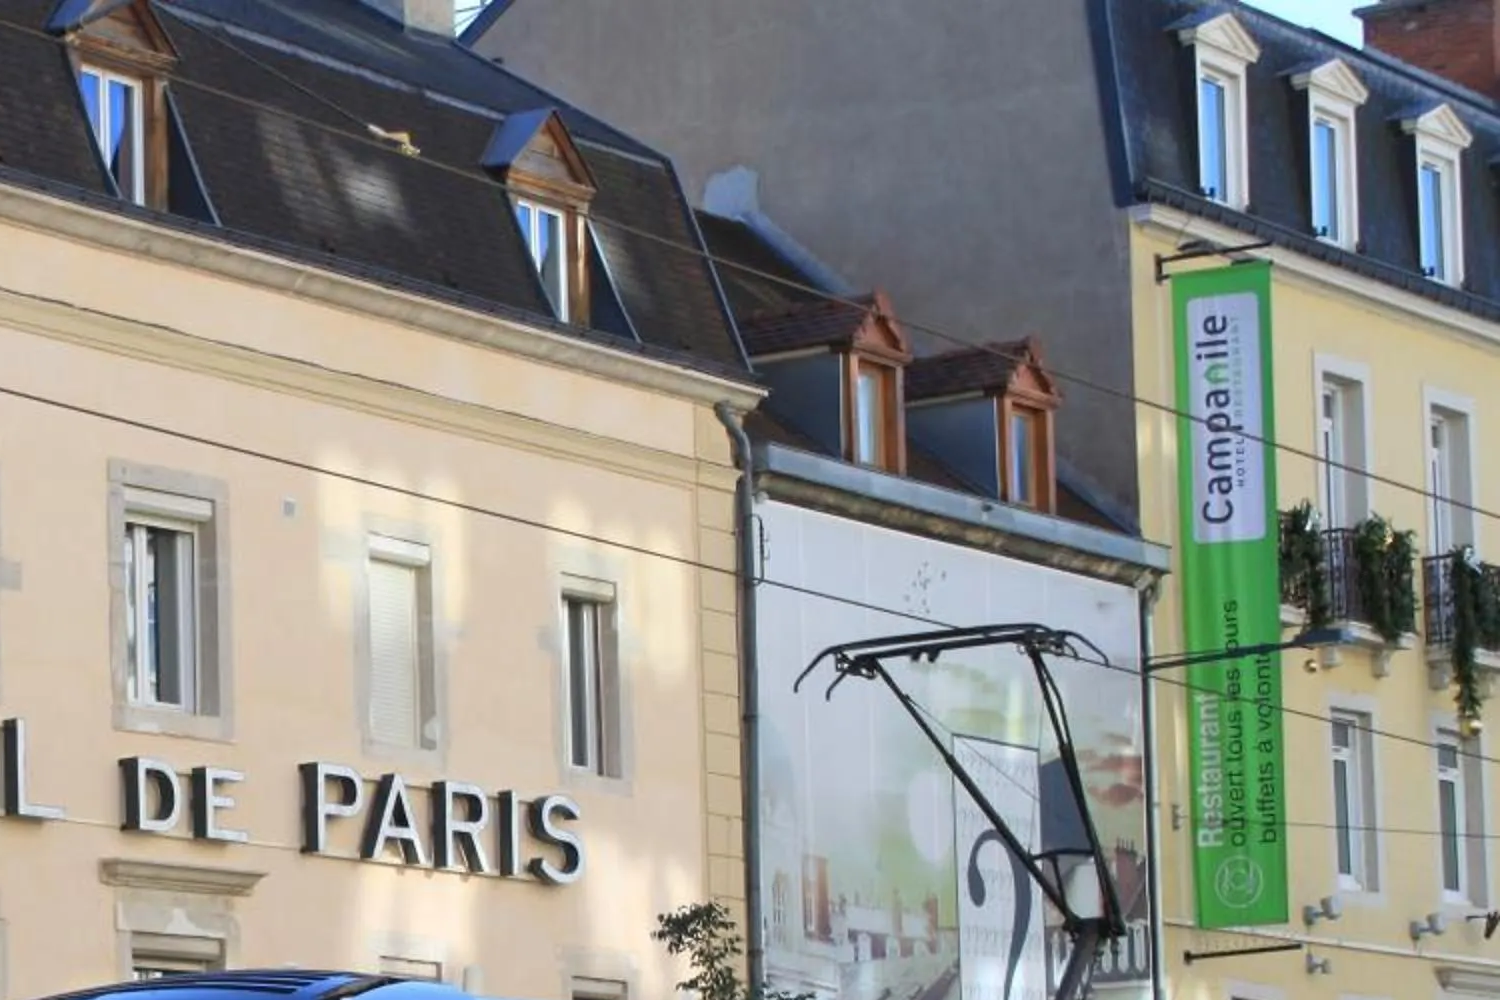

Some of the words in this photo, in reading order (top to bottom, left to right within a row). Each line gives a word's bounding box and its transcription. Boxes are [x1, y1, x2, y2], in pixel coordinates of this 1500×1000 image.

[1196, 314, 1244, 524] Campanile
[1235, 438, 1245, 488] HOTEL
[1223, 600, 1240, 657] ours
[1198, 690, 1223, 847] Restaurant
[1227, 709, 1243, 763] tous
[118, 756, 248, 843] DE
[298, 761, 586, 886] PARIS
[1229, 767, 1246, 847] ouvert
[1257, 762, 1277, 844] buffets
